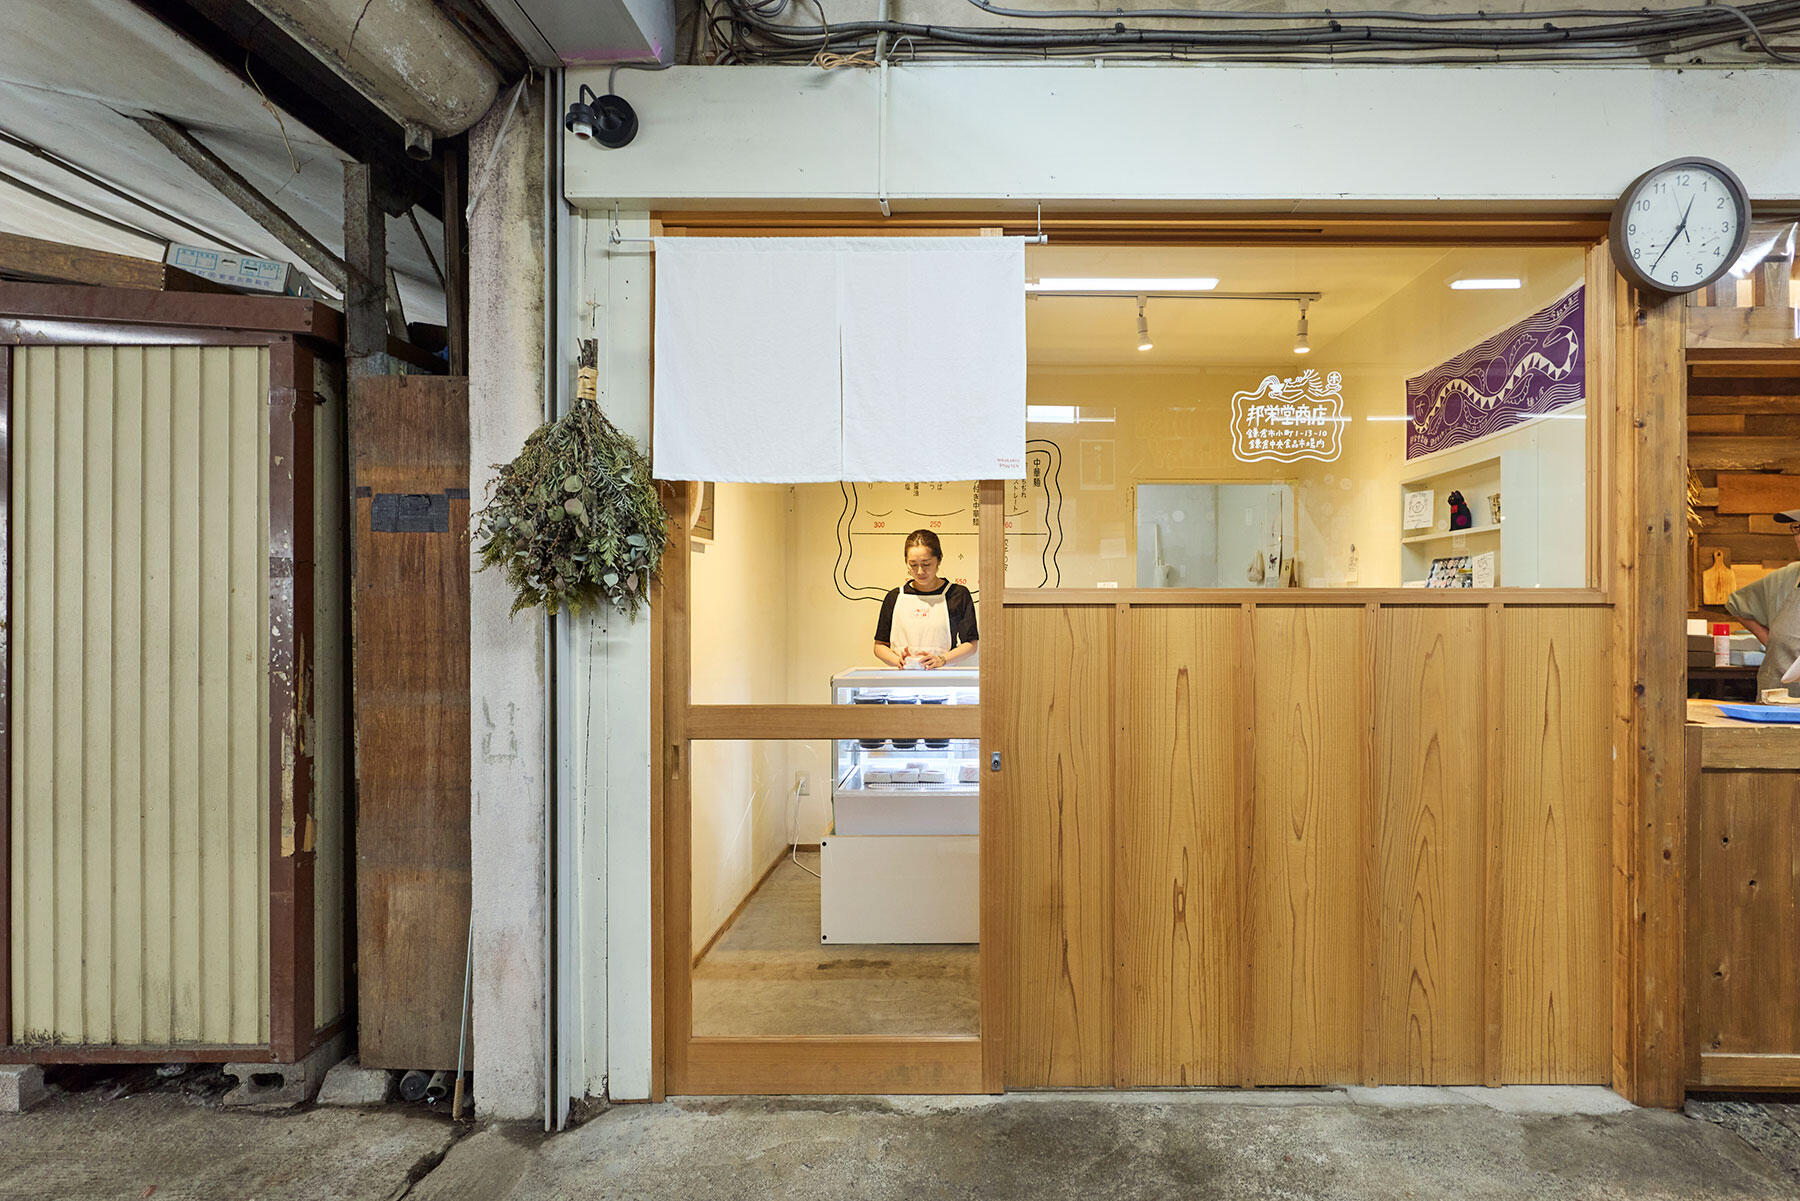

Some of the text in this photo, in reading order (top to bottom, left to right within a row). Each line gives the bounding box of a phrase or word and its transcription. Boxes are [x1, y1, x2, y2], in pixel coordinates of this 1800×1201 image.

[1676, 174, 1690, 187] 12
[1701, 181, 1708, 192] 1
[1653, 182, 1667, 194] 11
[1635, 199, 1651, 212] 10
[1716, 197, 1726, 209] 2
[1628, 223, 1637, 236] 9
[1721, 221, 1729, 233] 3
[1633, 247, 1641, 260] 8
[1712, 246, 1721, 257] 4
[1649, 264, 1657, 276] 7
[1695, 263, 1704, 275] 5
[1671, 270, 1679, 283] 6
[1246, 403, 1328, 427] 邦栄堂商店
[873, 521, 886, 529] 300
[929, 520, 942, 528] 250
